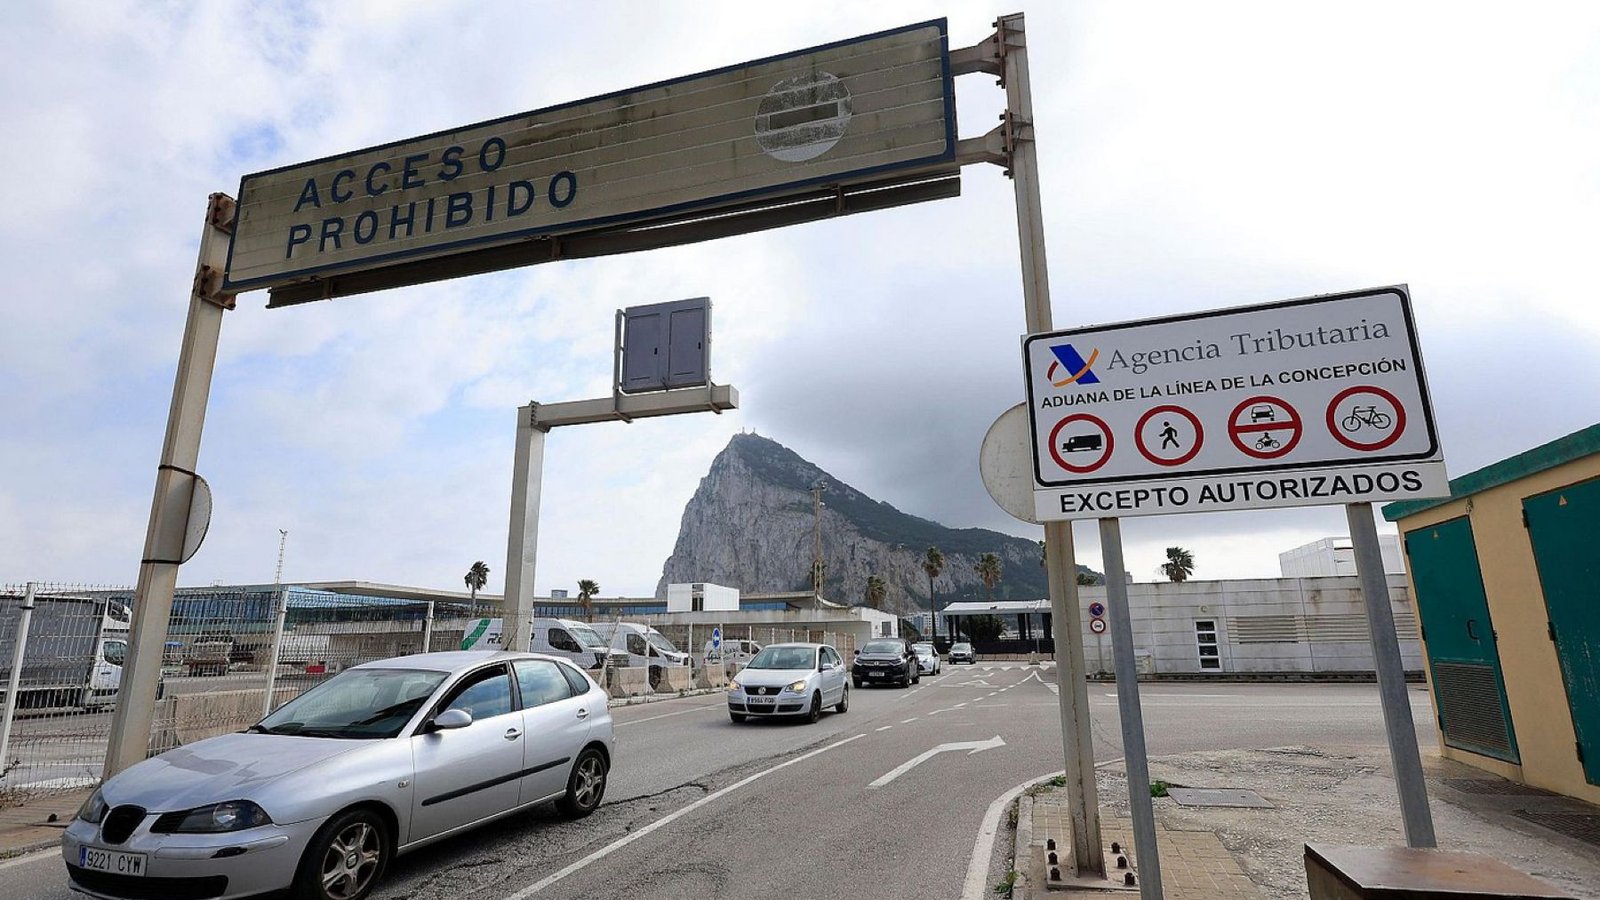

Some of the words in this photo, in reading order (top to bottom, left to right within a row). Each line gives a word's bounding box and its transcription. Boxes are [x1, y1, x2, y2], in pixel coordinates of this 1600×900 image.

[293, 137, 506, 213] ACCESO
[285, 170, 577, 259] PROHIBIDO
[1106, 339, 1221, 374] Agencia
[1230, 319, 1390, 355] Tributaria
[1041, 391, 1109, 409] ADUANA
[1113, 388, 1135, 401] DE
[1140, 386, 1161, 398] LA
[1166, 380, 1217, 396] LÍNEA
[1221, 376, 1245, 390] DE
[1250, 374, 1274, 387] LA
[1278, 357, 1406, 384] CONCEPCIÓN
[1060, 486, 1189, 513] EXCEPTO
[1198, 470, 1423, 504] AUTORIZADOS
[87, 851, 111, 870] 9221
[118, 855, 141, 873] CYW
